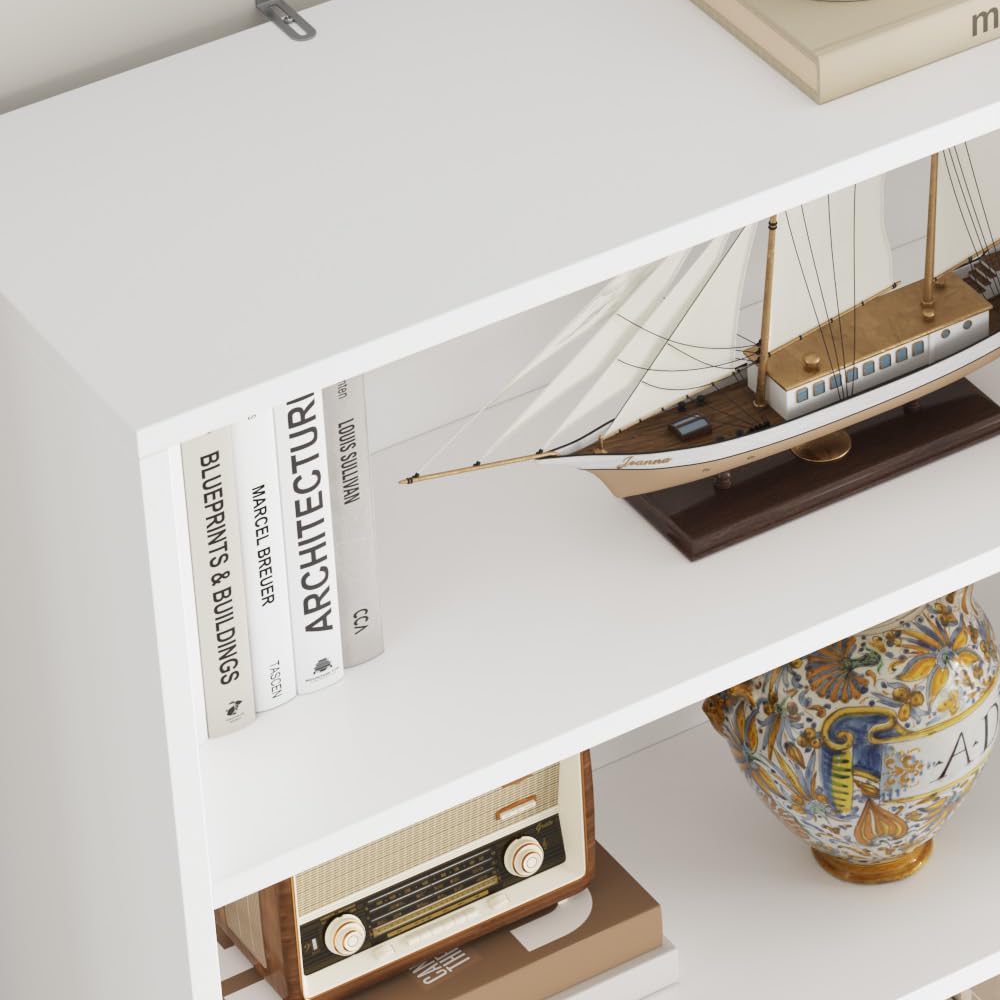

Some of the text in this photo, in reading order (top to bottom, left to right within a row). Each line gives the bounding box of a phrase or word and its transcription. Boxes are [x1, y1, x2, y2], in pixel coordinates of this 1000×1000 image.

[200, 451, 229, 568] BLUEPRINTS
[286, 392, 333, 633] ARCHITECTUR
[338, 418, 360, 505] LOUIS SULLIVAN
[211, 569, 231, 586] &
[252, 484, 275, 607] MARCEL BREUER
[212, 587, 240, 685] BUILDINGS
